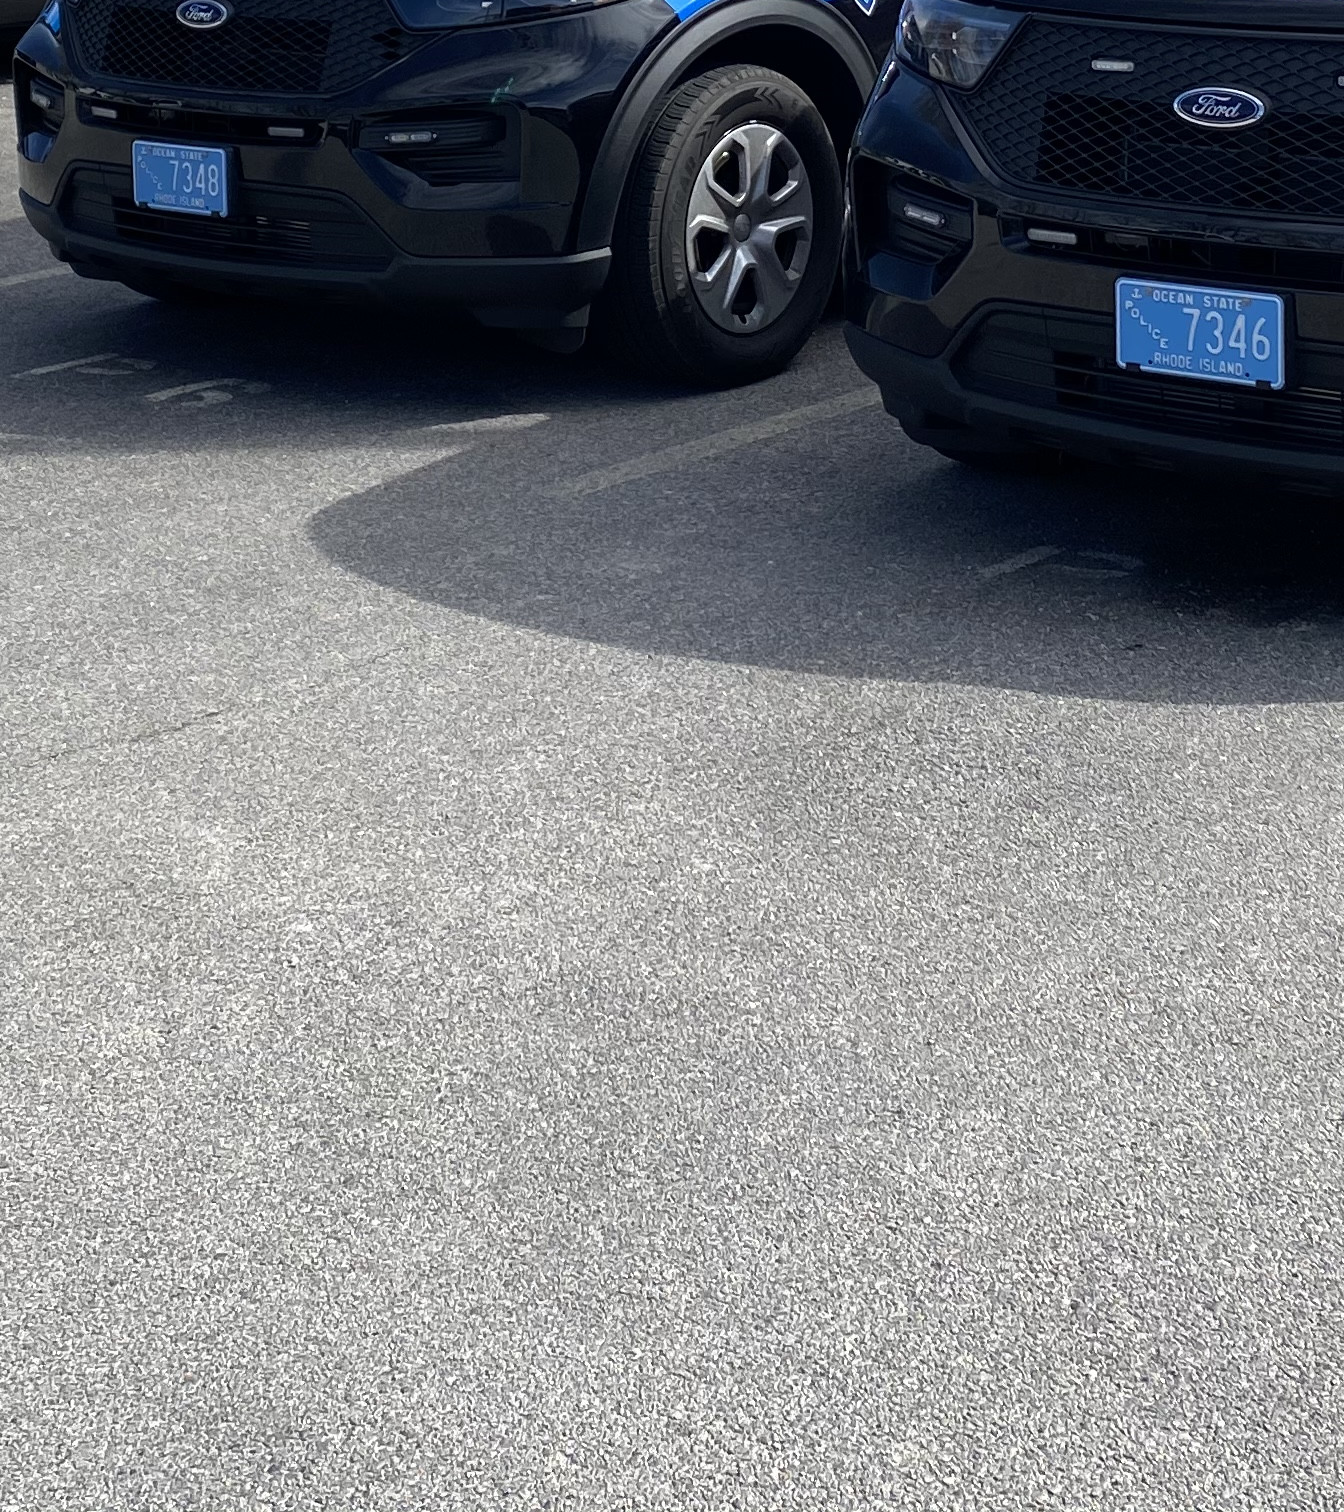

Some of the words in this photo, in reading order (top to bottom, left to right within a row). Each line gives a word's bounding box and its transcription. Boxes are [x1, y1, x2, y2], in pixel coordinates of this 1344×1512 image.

[185, 4, 212, 21] Ford
[1192, 94, 1241, 118] Ford
[180, 151, 203, 161] STATE
[169, 160, 219, 196] 7348
[179, 196, 204, 207] ISLAND
[1152, 289, 1194, 305] OCEAN
[1203, 295, 1243, 311] STATE
[1125, 300, 1168, 349] POLICE
[1183, 308, 1270, 361] 7346
[1154, 352, 1193, 369] RHODE
[1199, 359, 1243, 376] ISLAND
